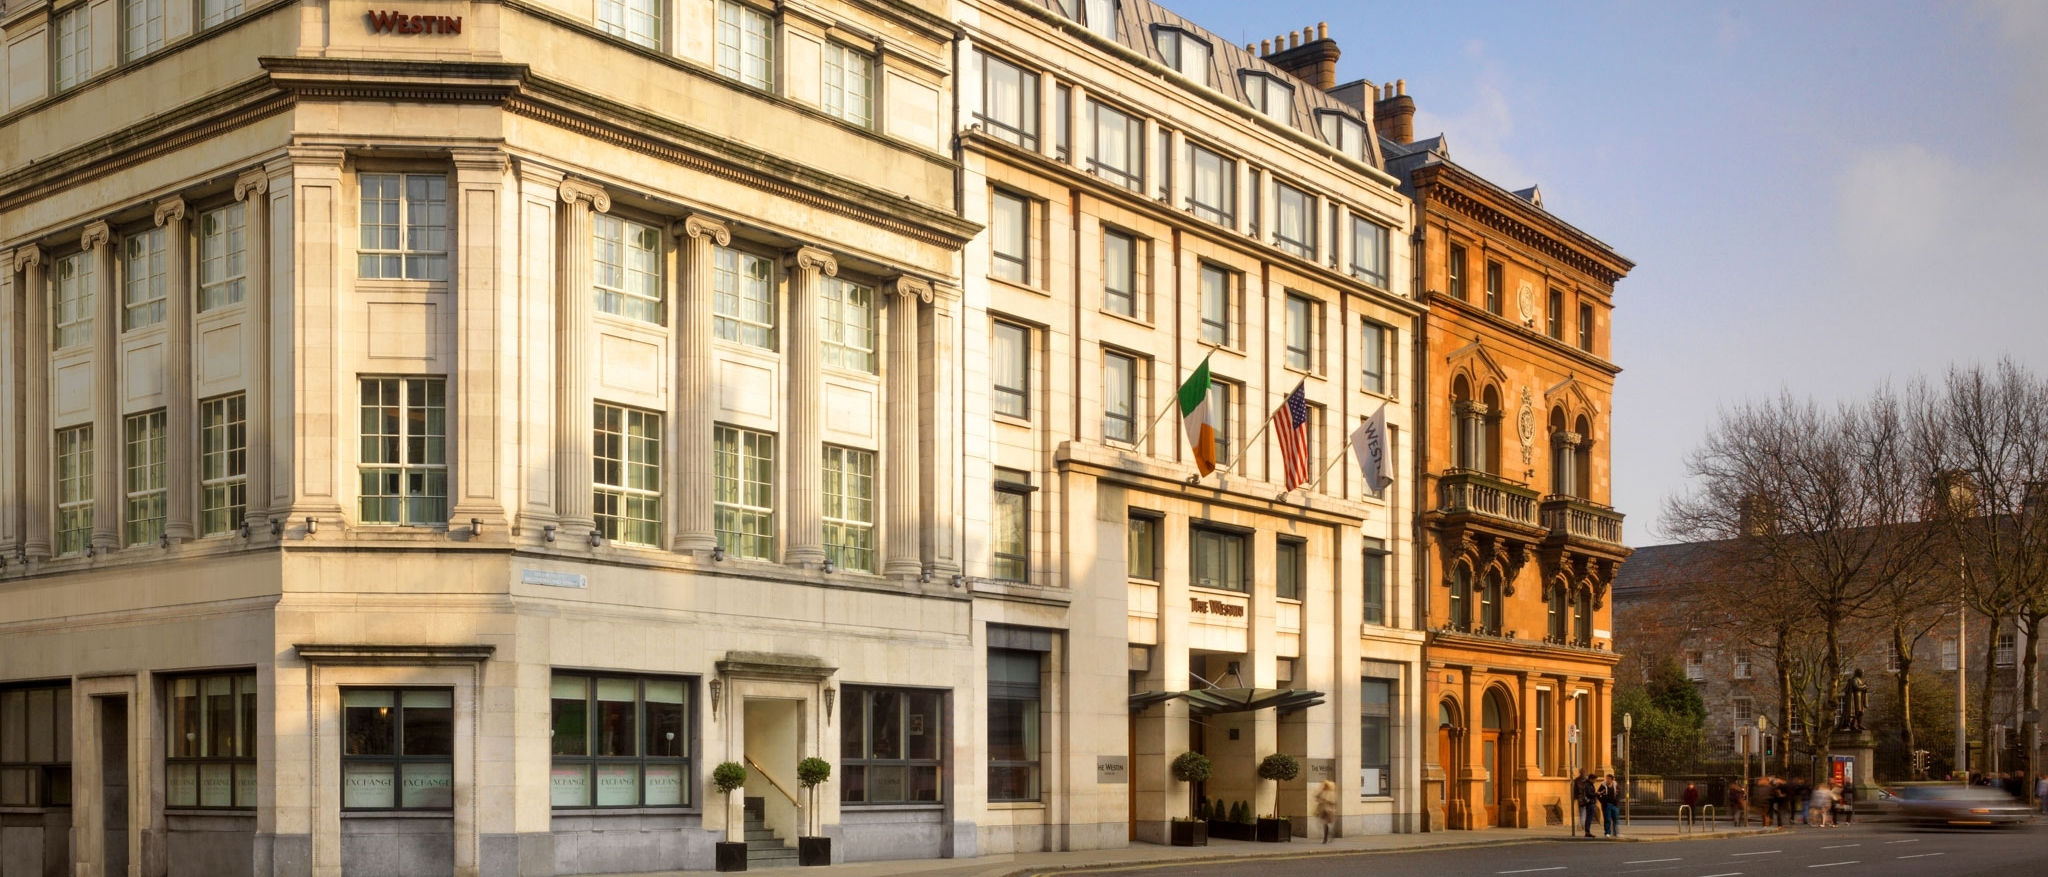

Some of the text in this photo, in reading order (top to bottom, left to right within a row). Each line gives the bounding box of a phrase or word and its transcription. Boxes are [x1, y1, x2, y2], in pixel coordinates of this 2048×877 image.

[368, 10, 462, 34] WESTIN
[1189, 598, 1244, 617] THE WESTIN
[346, 778, 391, 787] EXCHANGE
[404, 779, 449, 787] EXCHANGE
